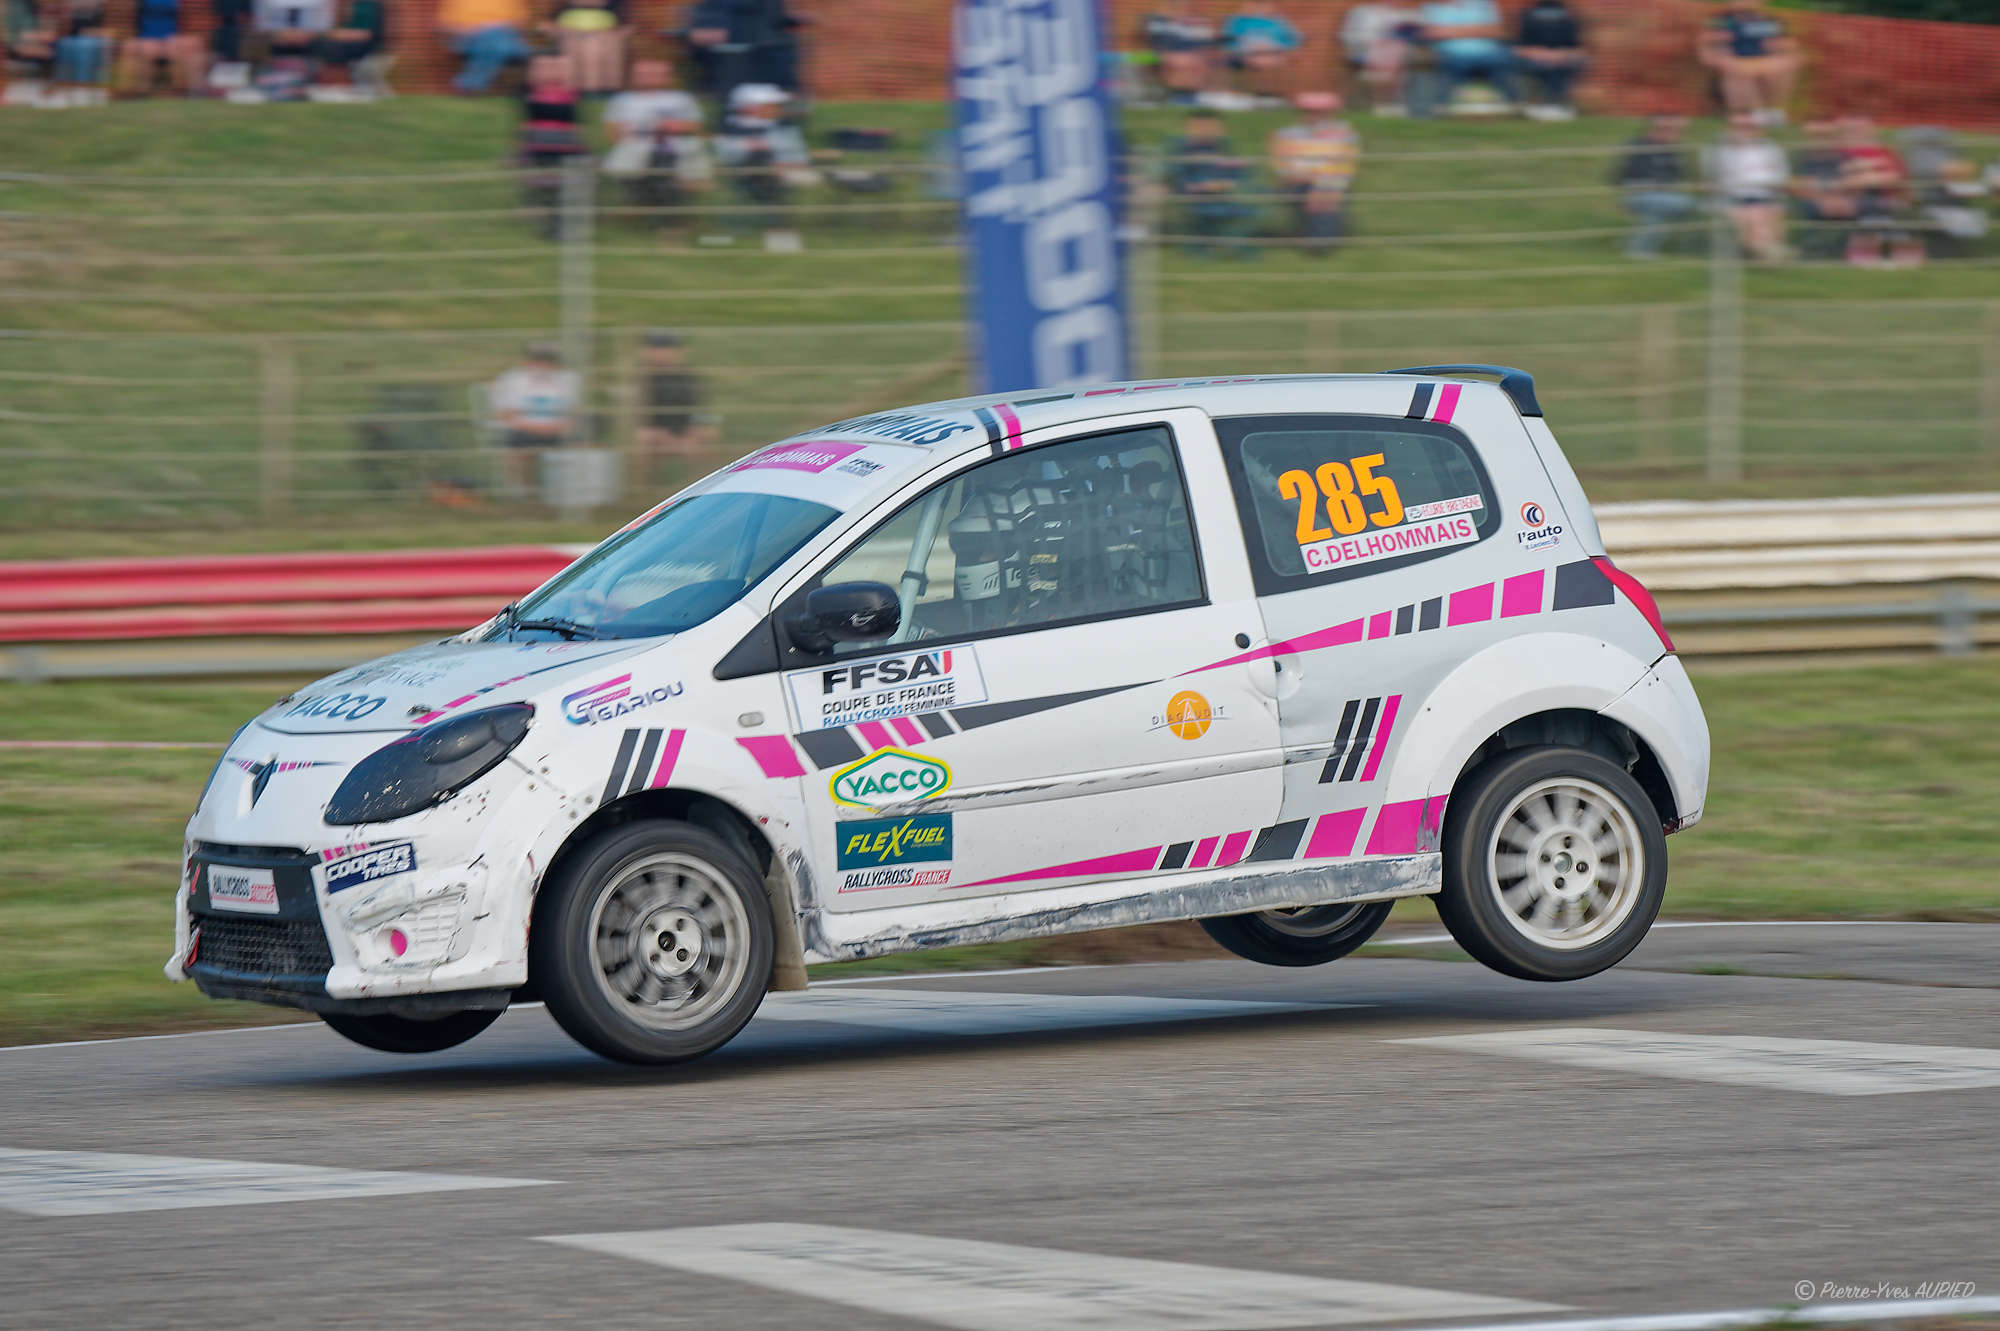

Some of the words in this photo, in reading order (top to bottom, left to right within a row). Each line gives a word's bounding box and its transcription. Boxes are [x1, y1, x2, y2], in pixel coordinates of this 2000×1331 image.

[1278, 453, 1404, 544] 285
[1307, 519, 1472, 567] C.DELHOMMAIS
[1518, 526, 1562, 543] l'auto
[823, 654, 940, 695] FFSA
[284, 692, 388, 721] YACCO
[598, 680, 684, 721] GARIOU
[823, 696, 870, 715] COUPE
[876, 691, 895, 706] DE
[900, 681, 955, 701] FRANCE
[823, 705, 903, 728] RALLYCROSS
[846, 768, 938, 797] YACCO
[326, 846, 410, 881] COOPER
[362, 858, 411, 881] TIRES
[844, 868, 914, 889] RALLYCROSS
[917, 870, 951, 886] FRANCE
